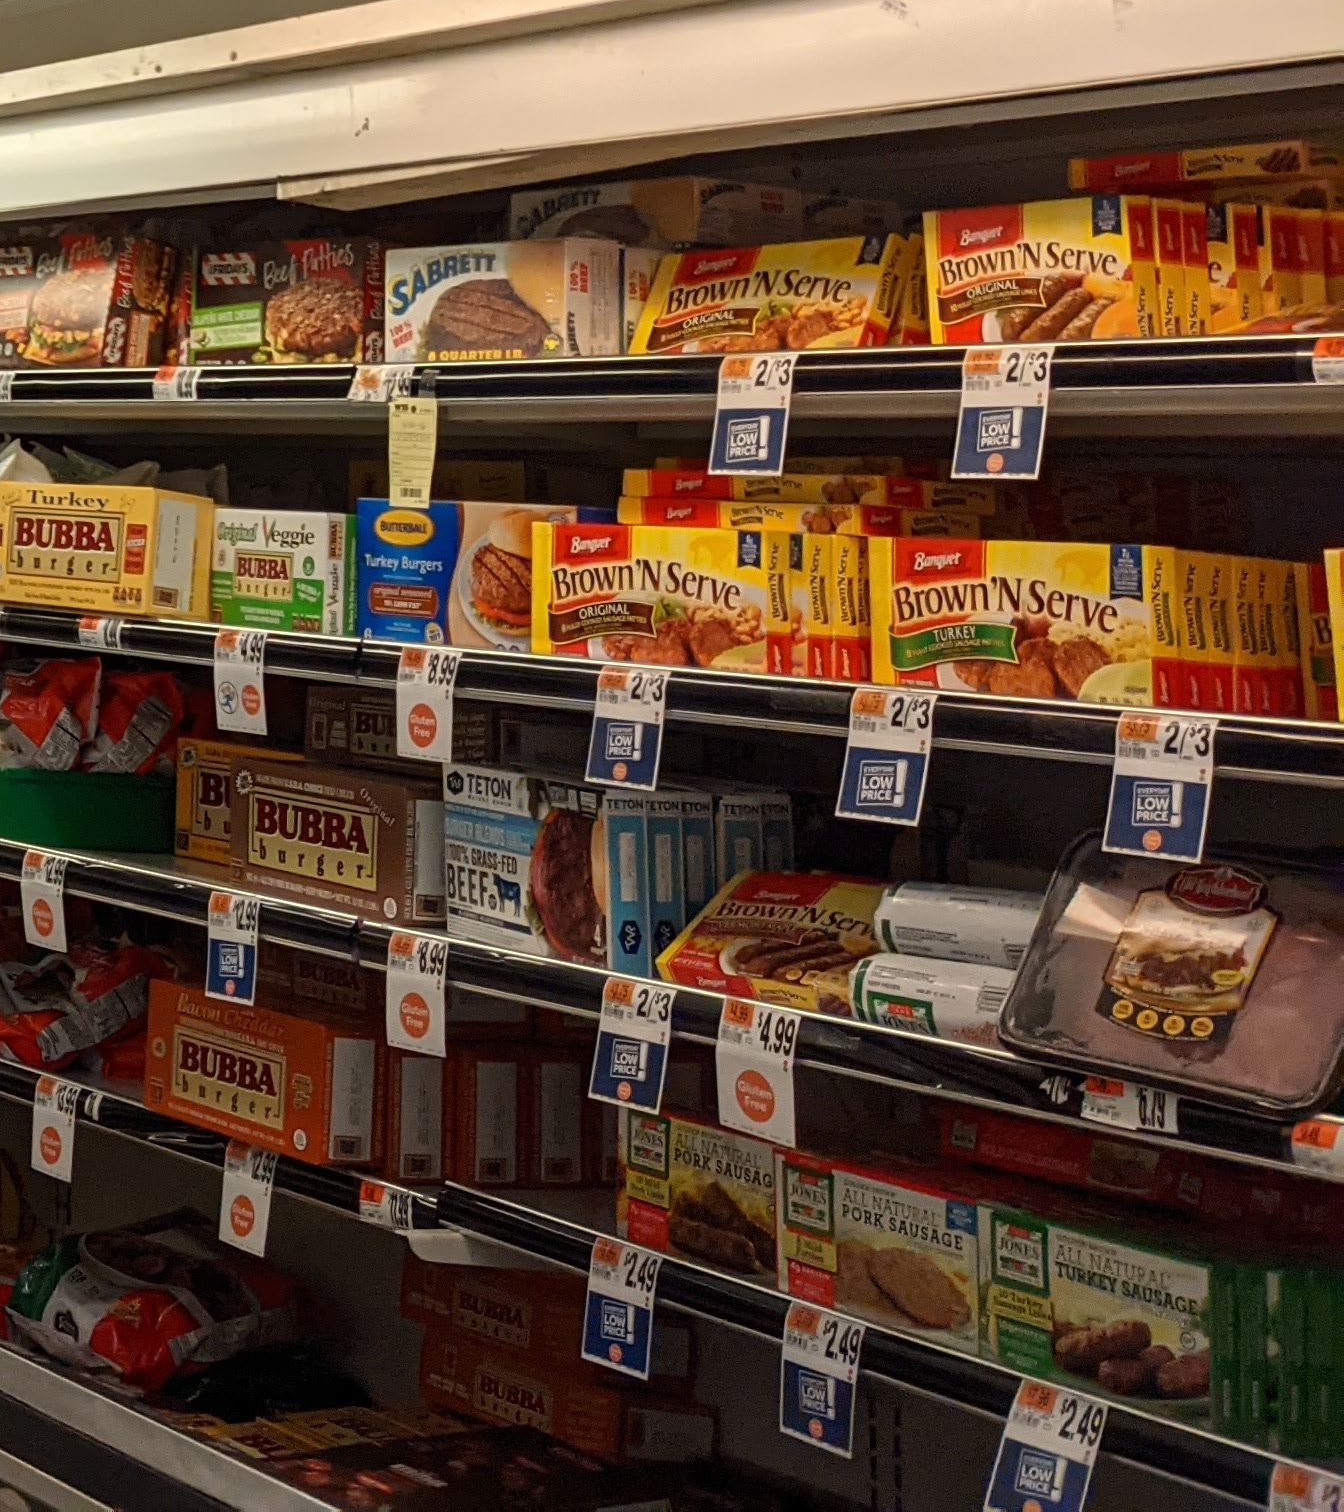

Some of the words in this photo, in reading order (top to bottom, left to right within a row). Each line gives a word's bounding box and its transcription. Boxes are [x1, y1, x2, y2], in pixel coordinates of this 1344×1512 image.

[263, 255, 299, 289] Beef
[302, 243, 354, 274] Patties
[1045, 241, 1118, 276] Serve
[390, 253, 496, 316] SABRETT
[783, 269, 852, 303] Serve
[967, 280, 1019, 299] ORIGINAL
[683, 309, 734, 329] ORIGINAL
[731, 432, 757, 445] LOW
[981, 436, 1009, 447] PRICE
[982, 423, 1010, 436] LOW
[729, 444, 757, 456] PRICE
[27, 489, 109, 511] Turkey
[15, 518, 114, 552] BUBBA
[262, 516, 315, 548] Veggie
[16, 551, 111, 576] burger
[237, 557, 288, 580] BUBBA
[365, 554, 398, 571] Turkey
[401, 557, 443, 574] Burgers
[914, 552, 962, 571] Banquet
[665, 561, 741, 611] Serve
[579, 604, 630, 620] ORIGINAL
[1026, 579, 1118, 633] Serve
[933, 625, 976, 642] TURKEY
[428, 653, 456, 687] $8.99
[414, 726, 430, 738] Free
[609, 735, 632, 746] LOW
[608, 747, 631, 756] PRICE
[466, 773, 511, 800] TETON
[861, 789, 892, 801] PRICE
[862, 777, 895, 789] LOW
[359, 787, 395, 828] Original
[607, 798, 644, 810] TETON
[1136, 797, 1169, 810] LOW
[1136, 810, 1169, 822] PRICE
[255, 798, 370, 854] BUBBA
[258, 839, 365, 879] burger
[471, 848, 518, 876] GRASS-FED
[447, 862, 489, 909] BEEF
[416, 940, 445, 977] $8.99
[177, 992, 220, 1020] Bacon
[758, 1011, 796, 1057] $4.99
[179, 1040, 277, 1097] BUBBA
[613, 1063, 638, 1076] PRICE
[614, 1052, 639, 1066] LOW
[181, 1073, 272, 1120] burger
[675, 1133, 695, 1151] ALL
[701, 1138, 759, 1165] NATURAL
[674, 1148, 711, 1171] PORK
[715, 1159, 773, 1188] SAUSAG
[791, 1185, 827, 1205] JONES
[842, 1188, 867, 1208] ALL
[872, 1195, 938, 1227] NATURAL
[842, 1204, 884, 1229] PORK
[889, 1218, 963, 1251] SAUSAGE
[998, 1237, 1040, 1260] JONES
[622, 1251, 657, 1294] $2.49
[1055, 1244, 1081, 1264] ALL
[1089, 1252, 1165, 1287] NATURAL
[1055, 1261, 1118, 1294] TURKEY
[1121, 1279, 1199, 1317] SAUSAGE
[603, 1313, 626, 1329] LOW
[822, 1319, 861, 1366] $2.49
[801, 1383, 826, 1402] LOW
[1058, 1398, 1105, 1448] $2.49
[1021, 1464, 1053, 1481] LOW
